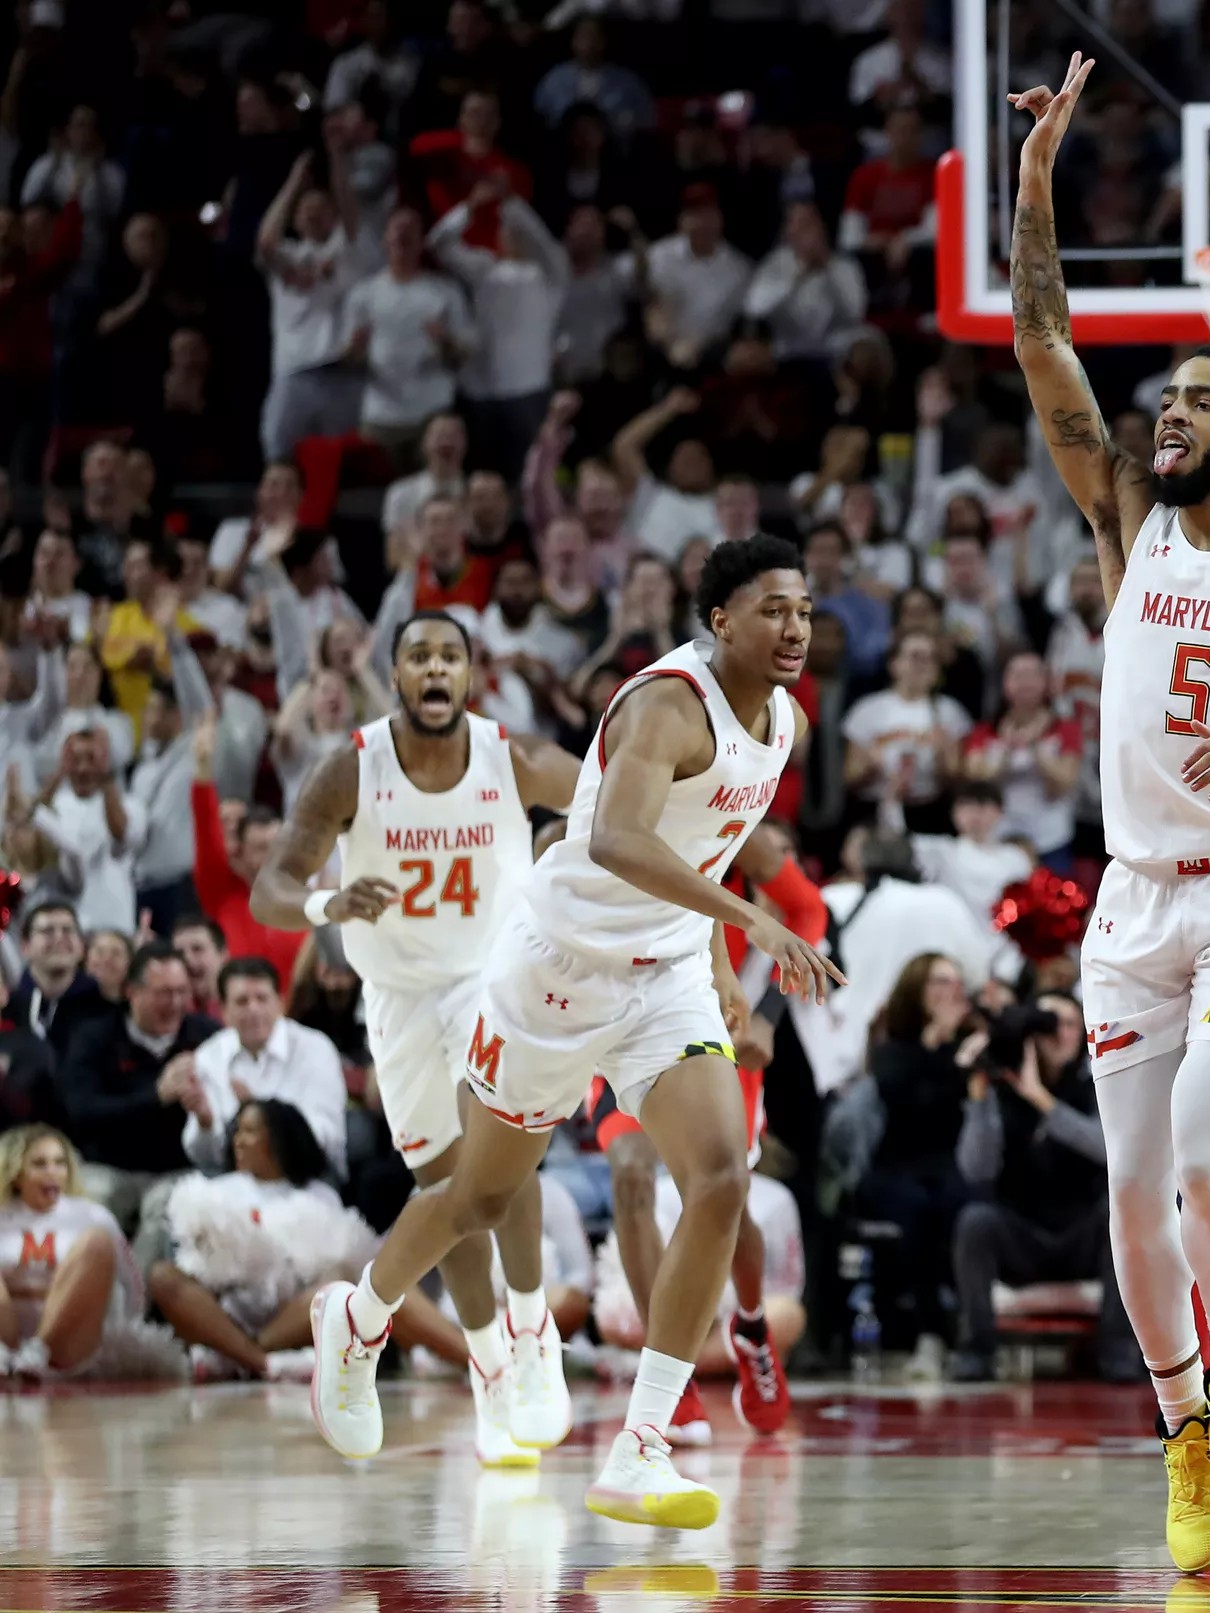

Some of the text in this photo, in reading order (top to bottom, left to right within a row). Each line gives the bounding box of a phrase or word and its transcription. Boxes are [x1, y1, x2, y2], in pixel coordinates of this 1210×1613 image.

[386, 823, 494, 852] MARYLAND
[399, 856, 480, 917] 24
[467, 1010, 506, 1087] M
[20, 1229, 57, 1270] M
